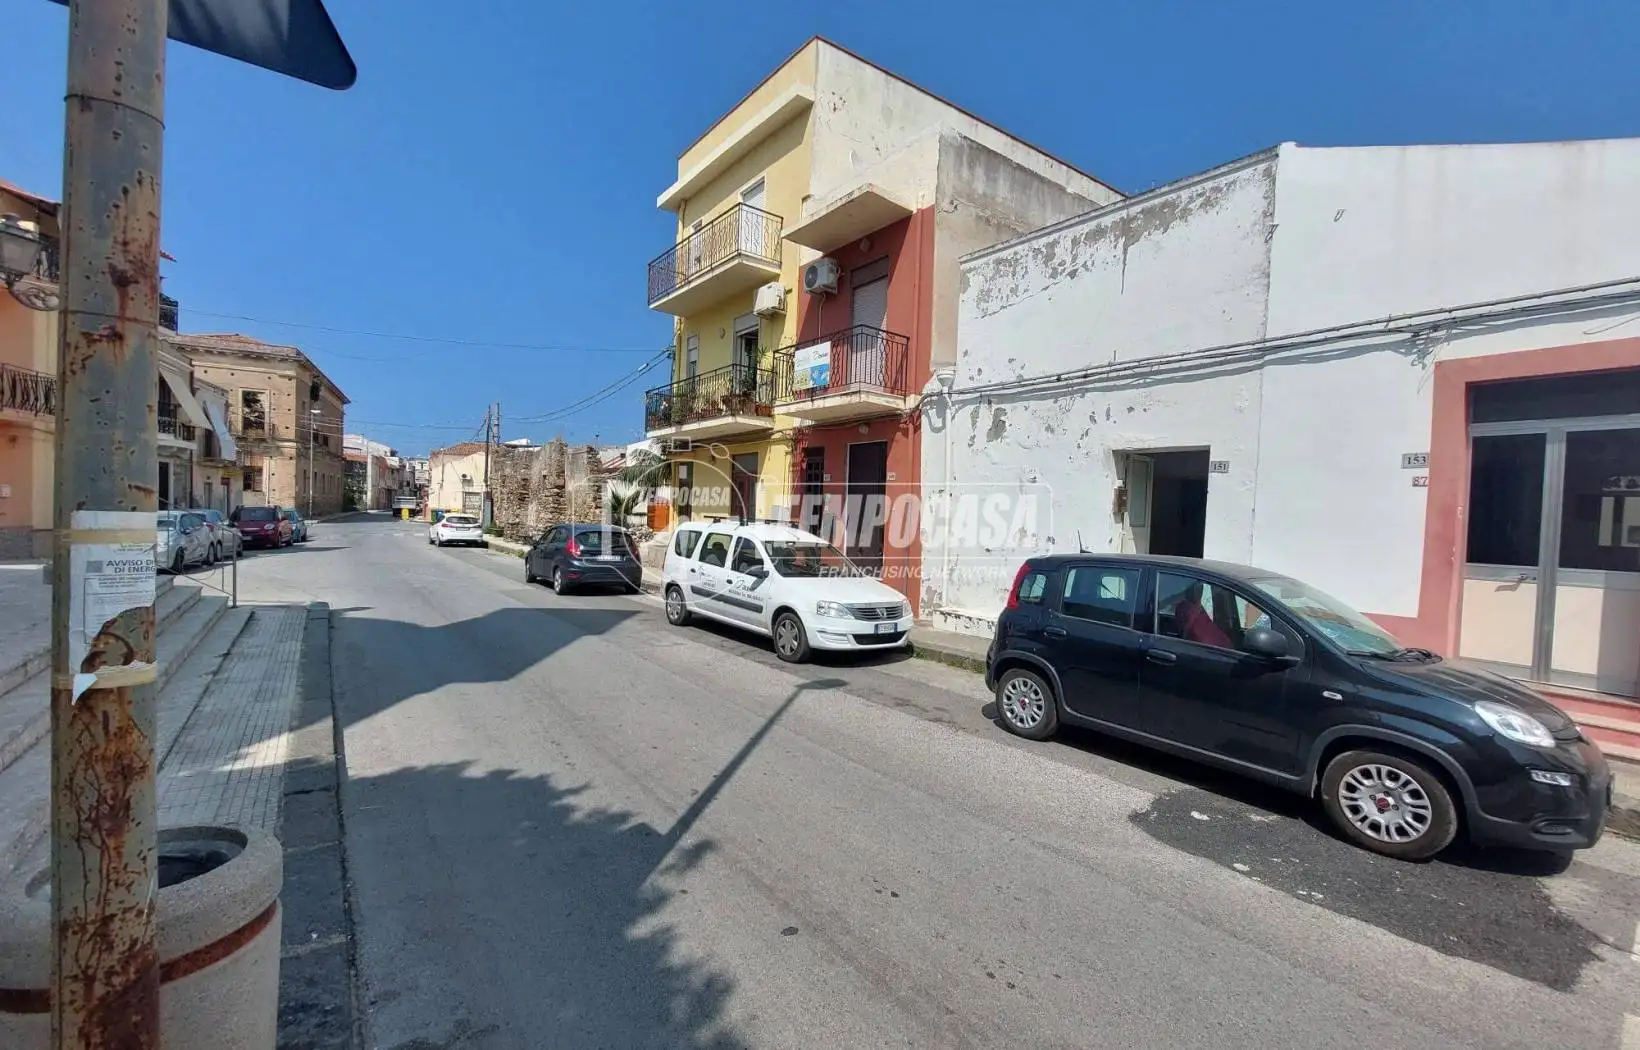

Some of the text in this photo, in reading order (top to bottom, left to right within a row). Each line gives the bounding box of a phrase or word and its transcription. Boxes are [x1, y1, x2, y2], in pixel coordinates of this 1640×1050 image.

[1407, 456, 1427, 465] 153
[1213, 463, 1227, 471] 151
[1412, 476, 1428, 486] 87
[106, 559, 143, 567] AVVISO
[114, 566, 125, 574] DI
